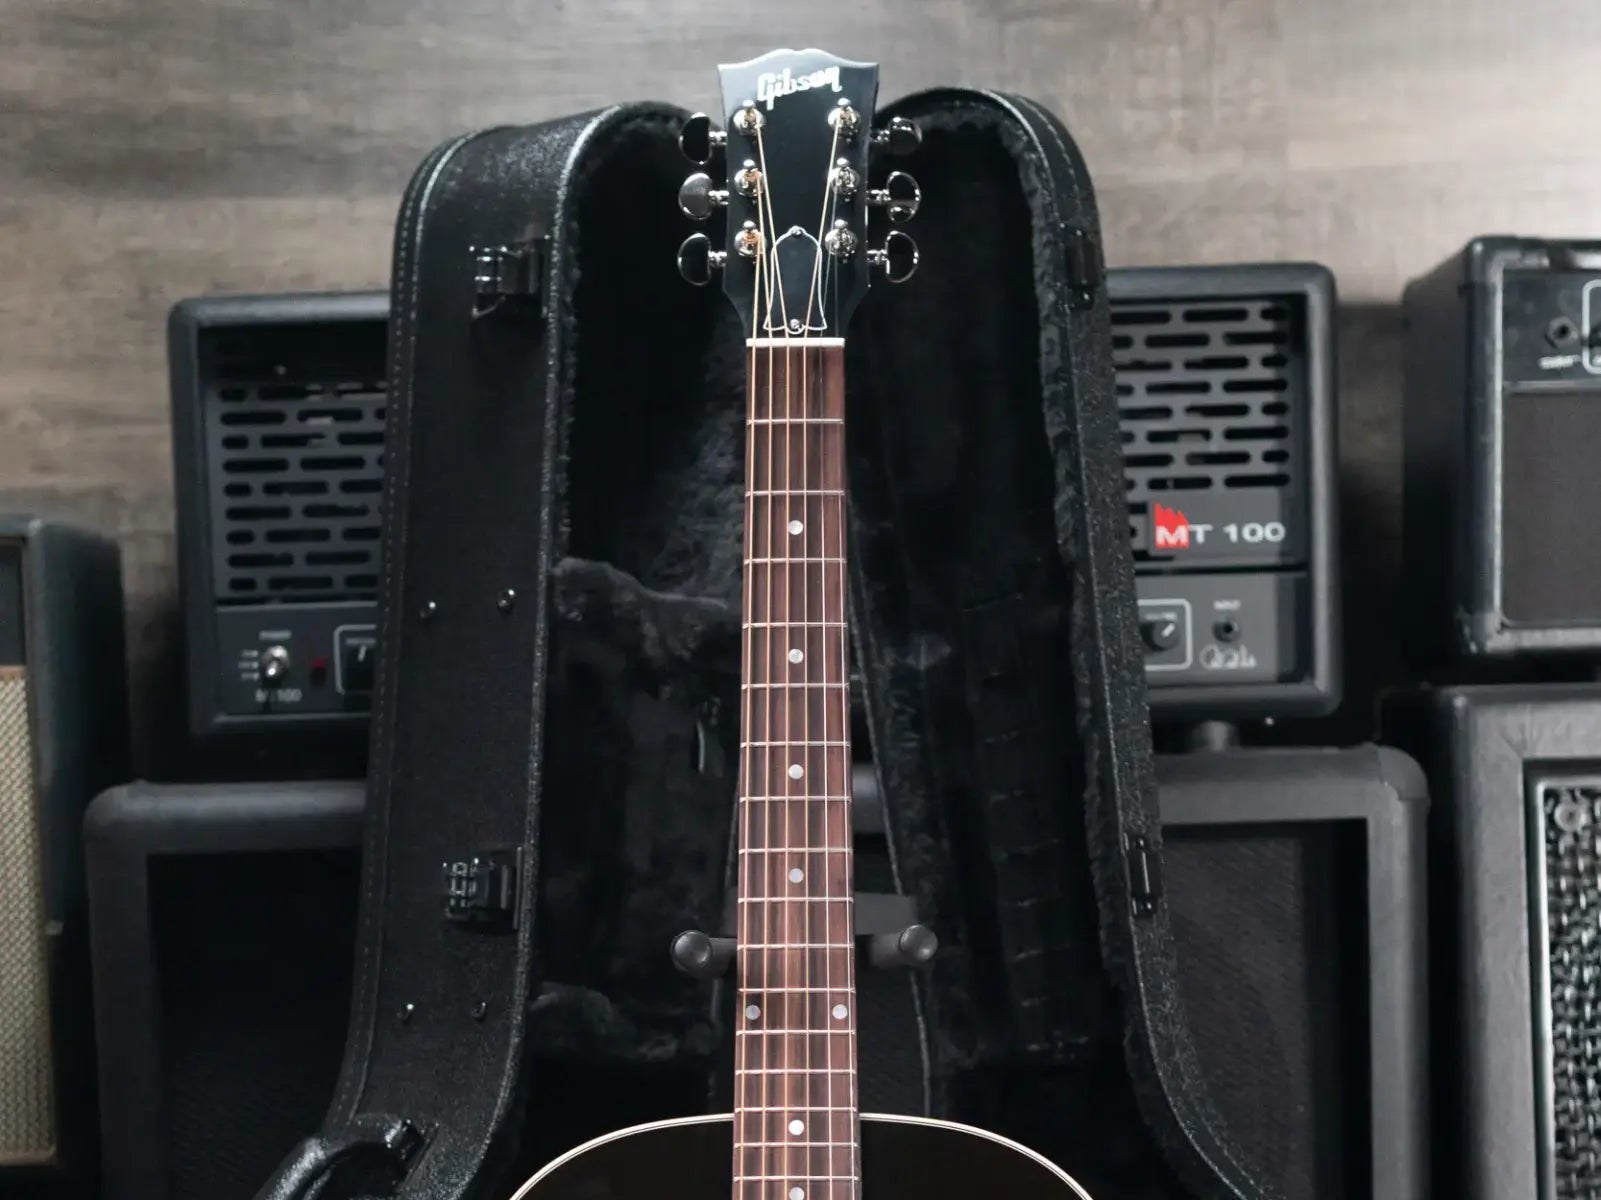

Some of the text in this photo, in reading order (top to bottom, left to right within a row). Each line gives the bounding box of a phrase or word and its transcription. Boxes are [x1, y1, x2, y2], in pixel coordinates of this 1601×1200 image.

[758, 66, 842, 111] Gibson
[1155, 521, 1285, 546] MT 100
